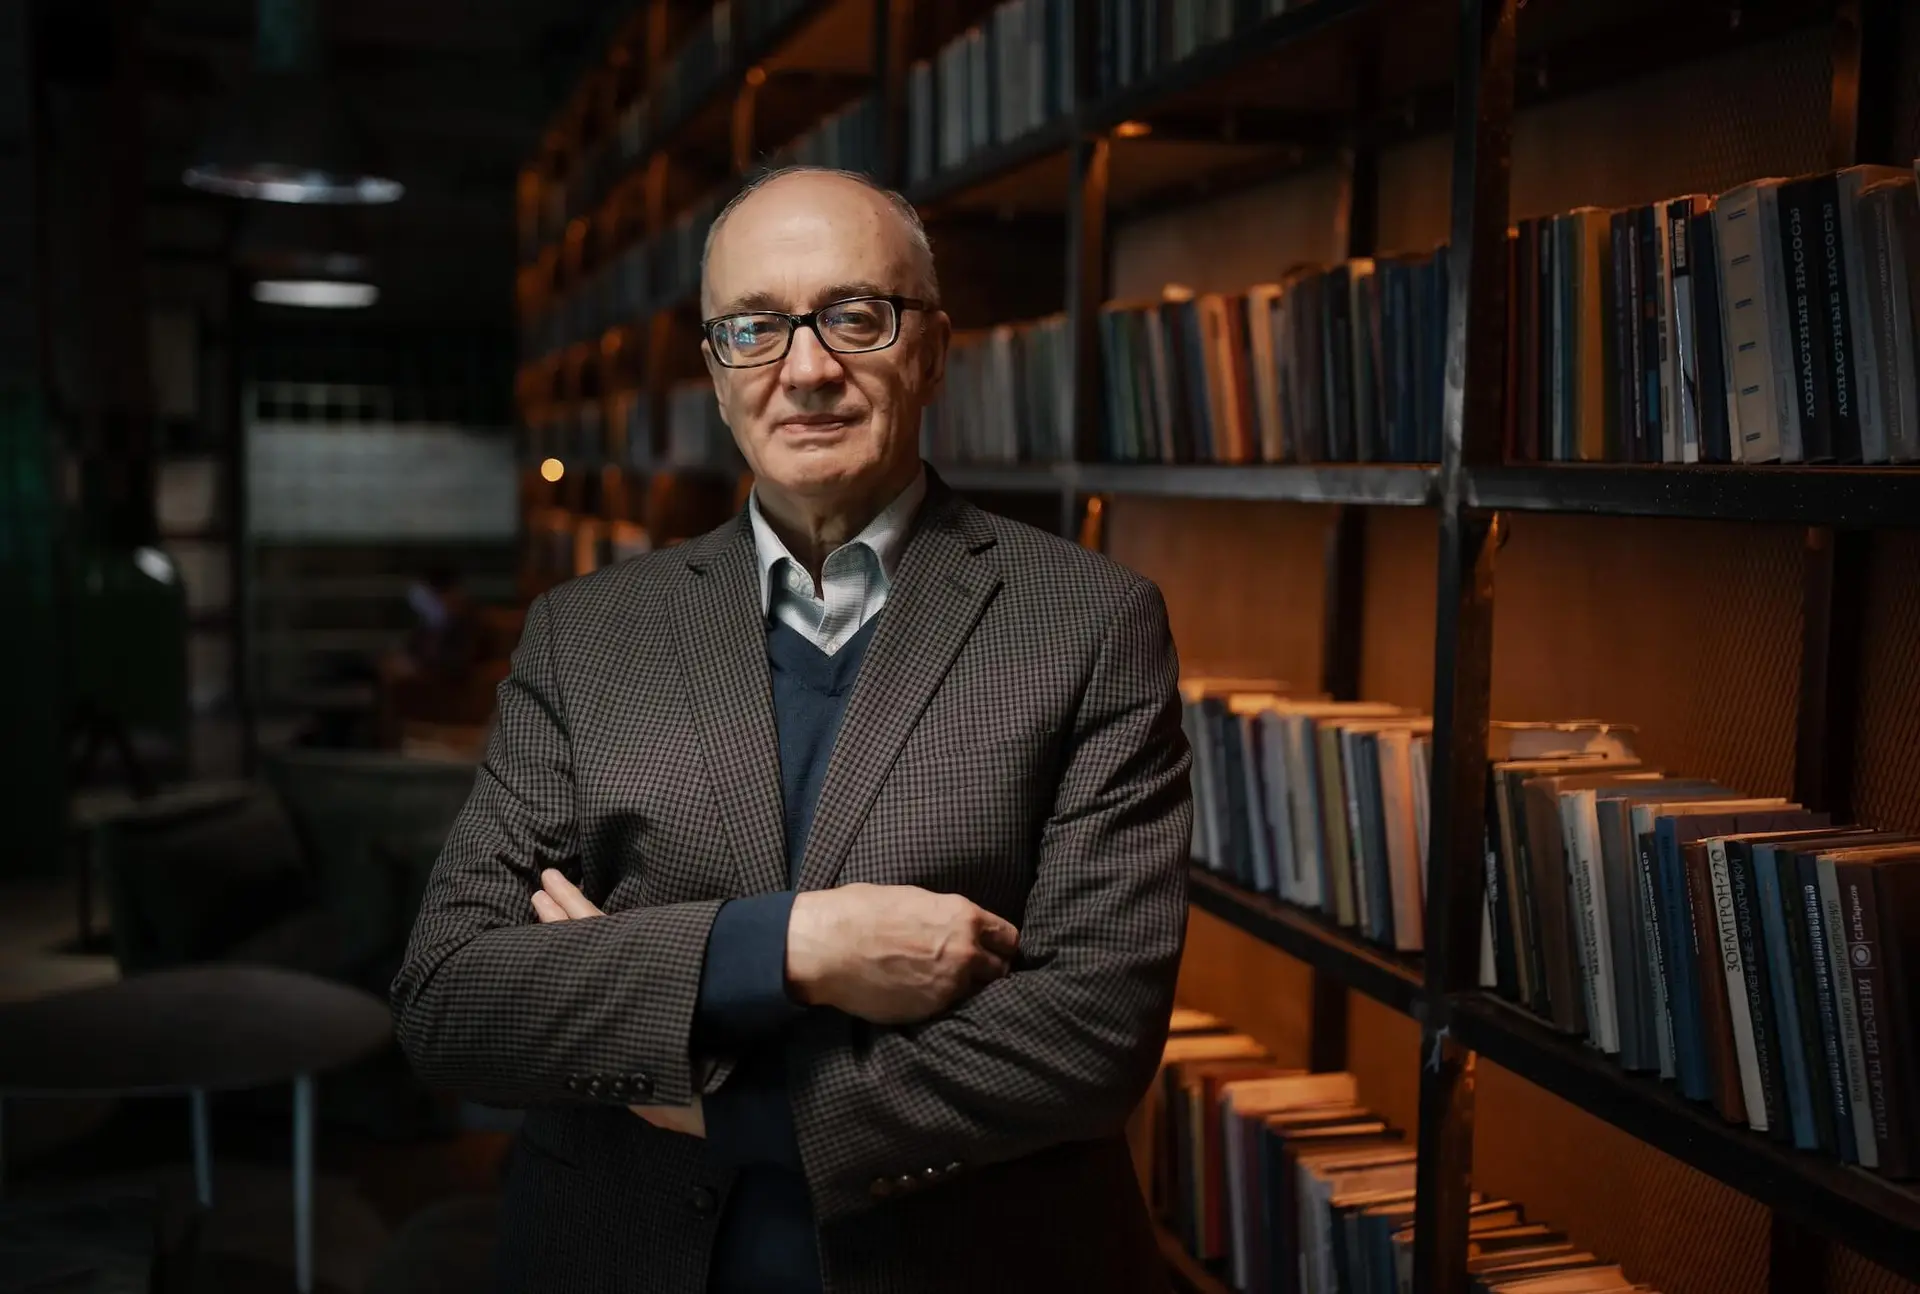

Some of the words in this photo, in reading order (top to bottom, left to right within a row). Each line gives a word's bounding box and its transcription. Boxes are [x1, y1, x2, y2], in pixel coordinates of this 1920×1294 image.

[1789, 207, 1808, 290] НАСОСЫ
[1823, 203, 1838, 289] НАСОСЫ
[1797, 293, 1816, 418] ЛОПАСТНЫЕ
[1830, 291, 1849, 418] ЛОПАСТНЫЕ
[1711, 848, 1740, 973] ЗОЕМТРОН-220
[1730, 857, 1753, 938] ЗАДАТЧИКИ
[1857, 975, 1879, 1056] ВРЕМЕНИ
